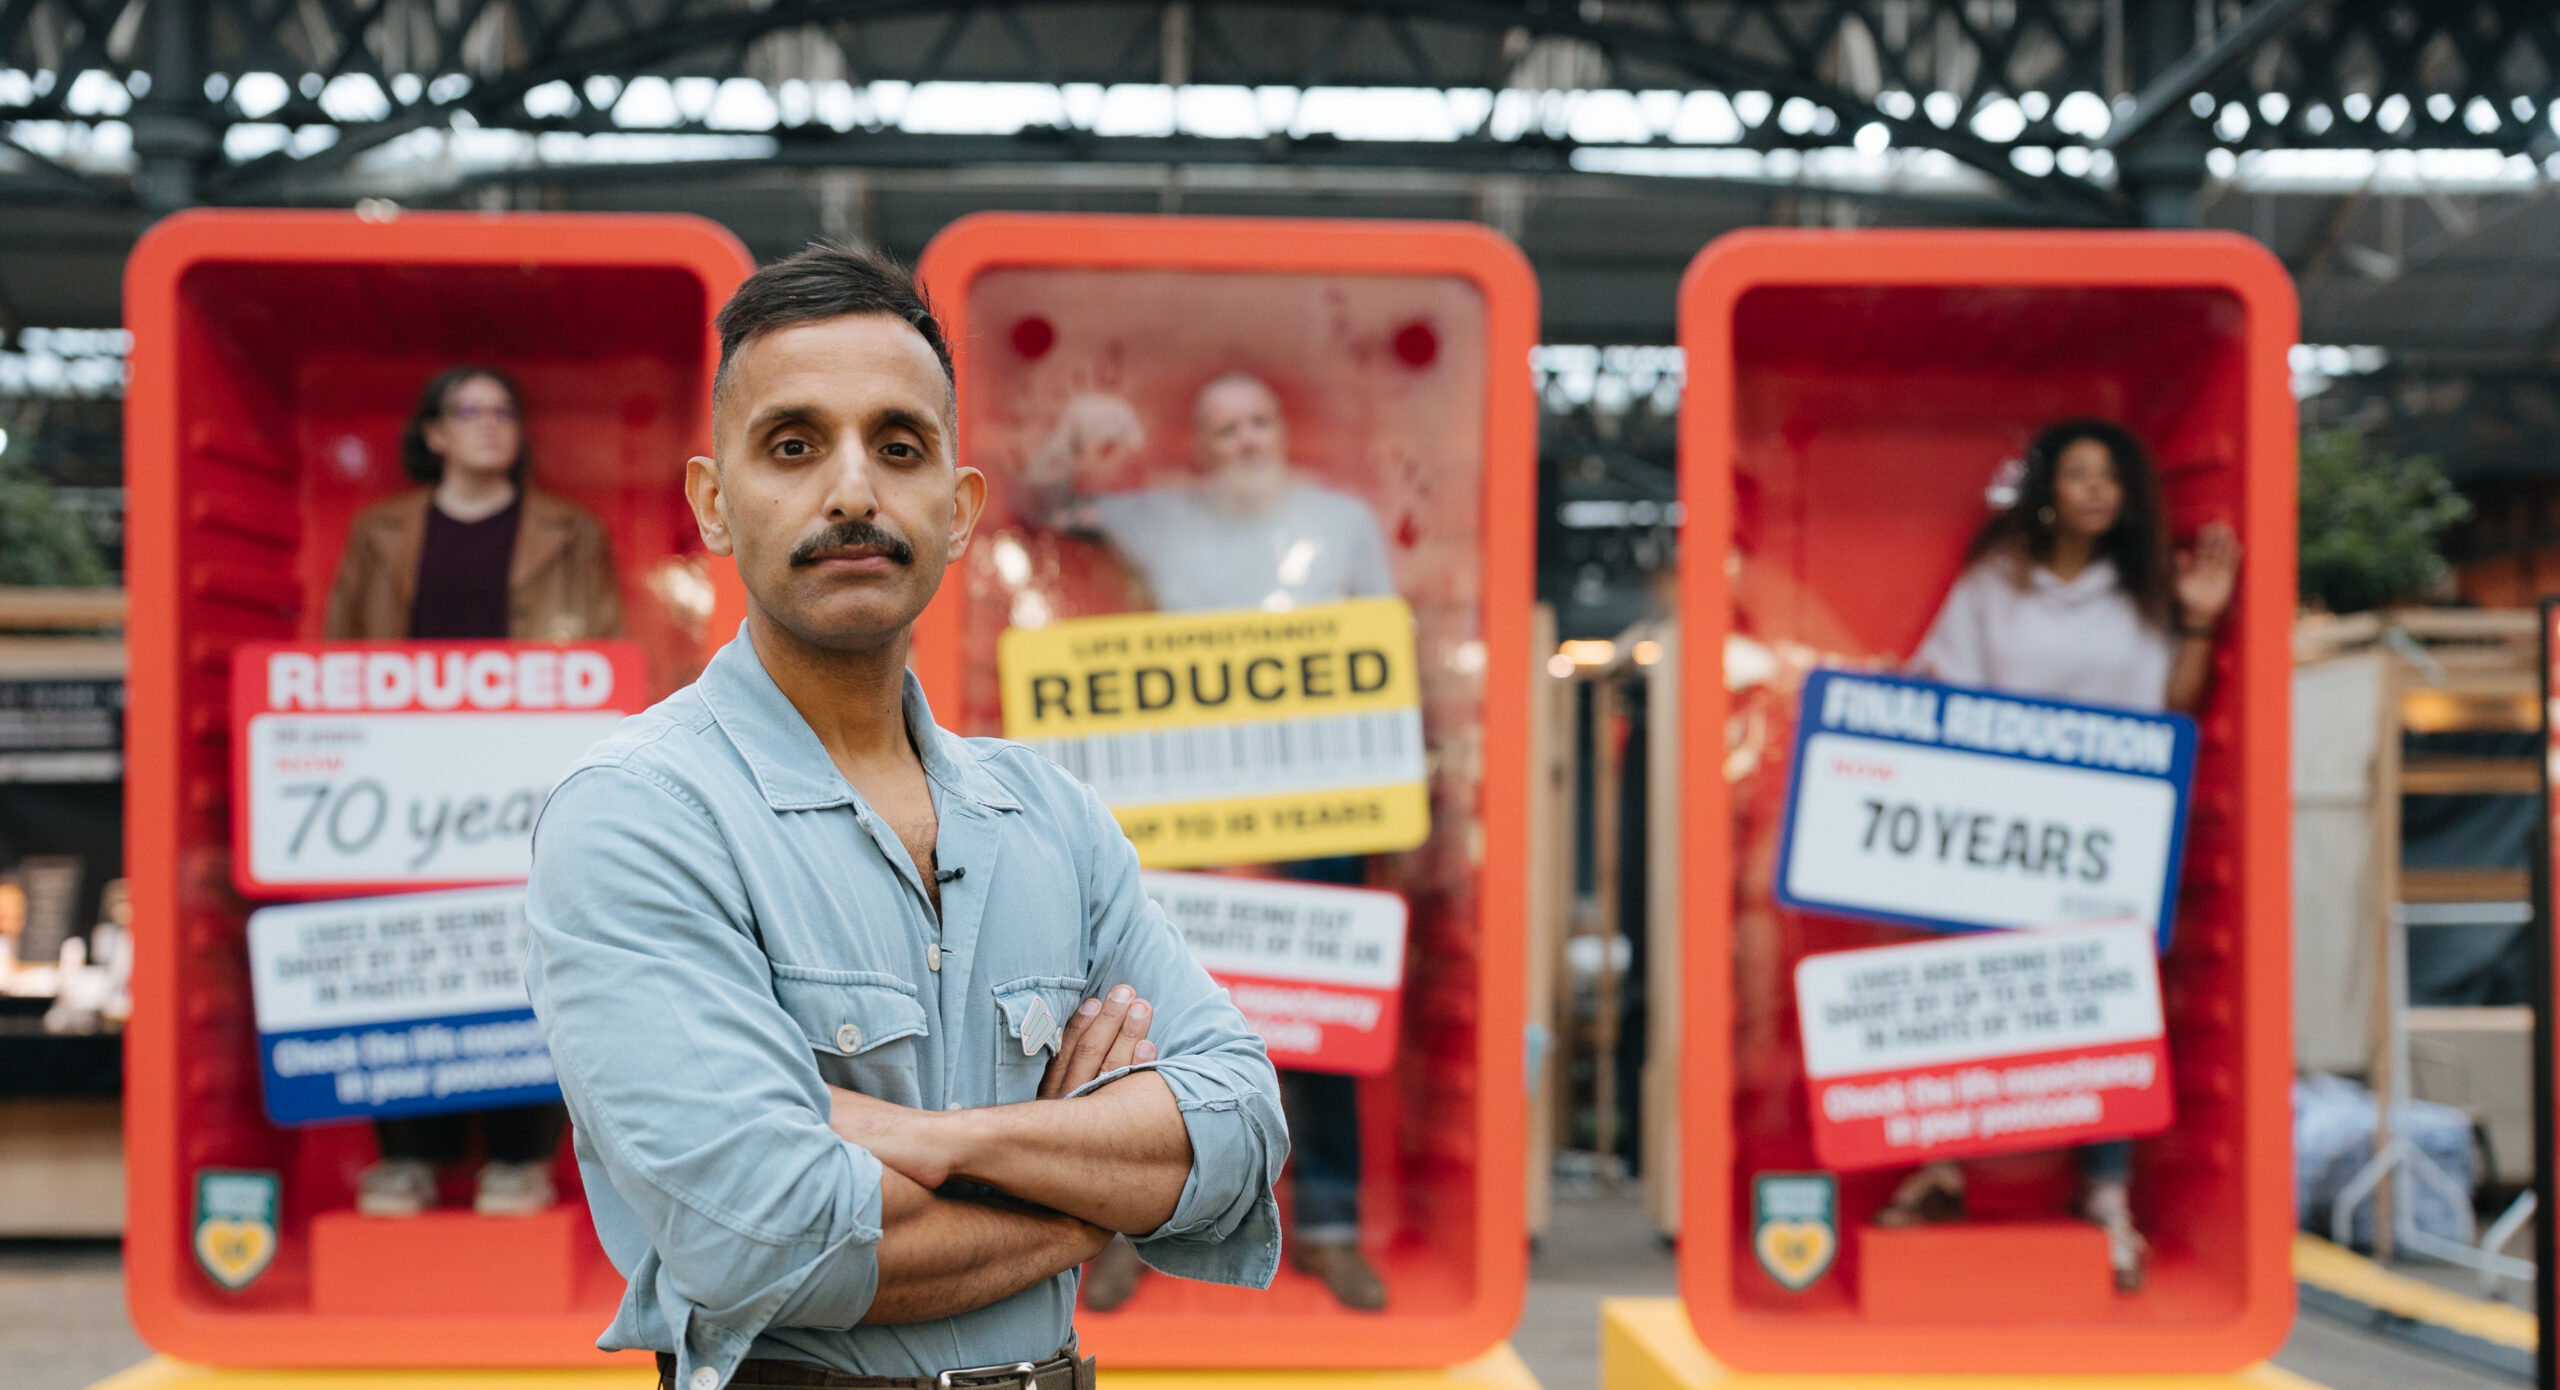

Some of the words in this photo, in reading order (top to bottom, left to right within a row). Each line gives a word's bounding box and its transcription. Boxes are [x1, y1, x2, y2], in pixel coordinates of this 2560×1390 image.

[267, 649, 616, 711] REDUCED
[1030, 648, 1391, 721] REDUCED
[1821, 677, 1940, 743] FINAL
[1943, 693, 2177, 775] REDUCTION
[278, 778, 389, 859] 70
[405, 785, 554, 874] yea
